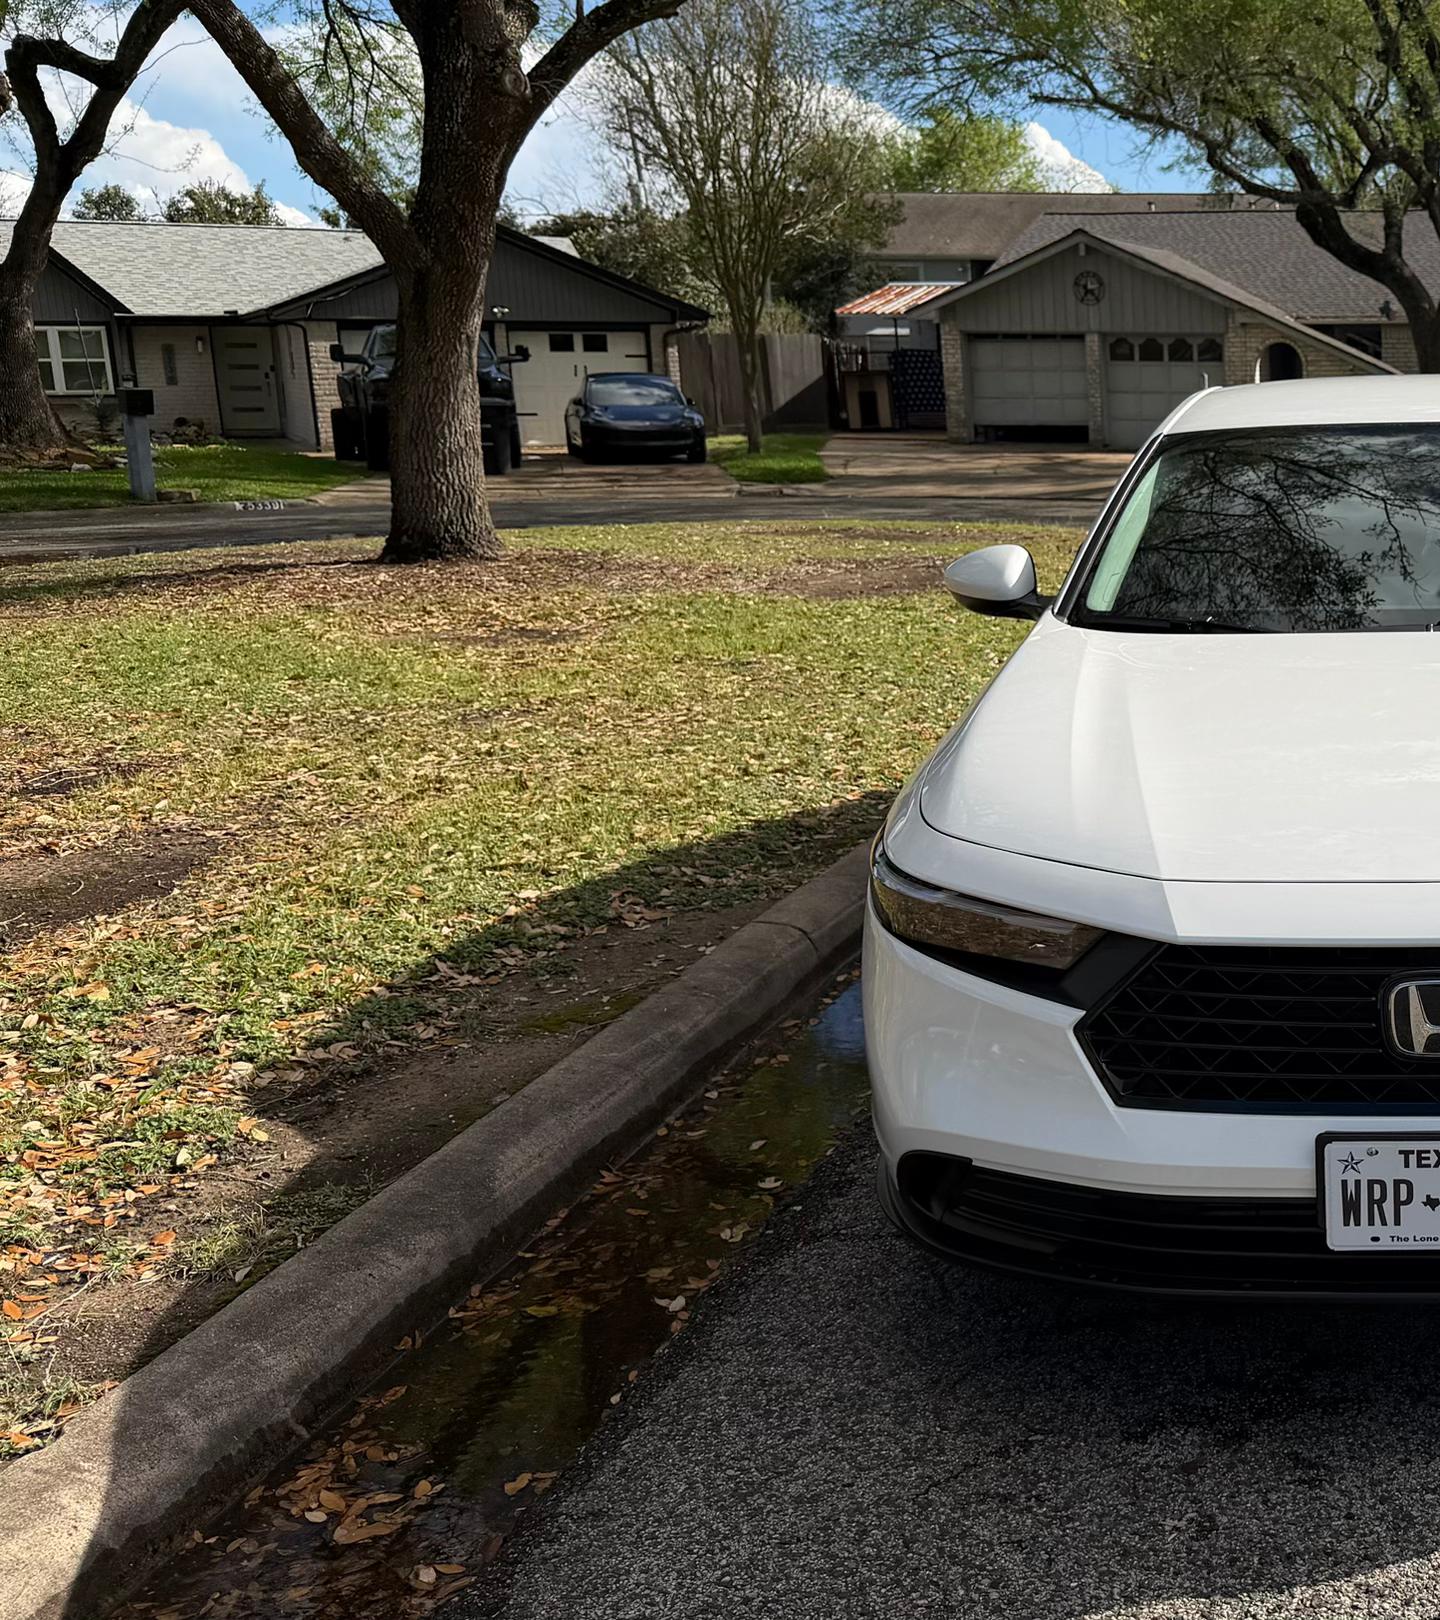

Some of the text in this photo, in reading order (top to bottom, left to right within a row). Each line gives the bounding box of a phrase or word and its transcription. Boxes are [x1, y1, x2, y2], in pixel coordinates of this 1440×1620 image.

[1340, 1178, 1415, 1228] WRP
[1389, 1235, 1410, 1243] The
[1413, 1235, 1440, 1243] Lone
